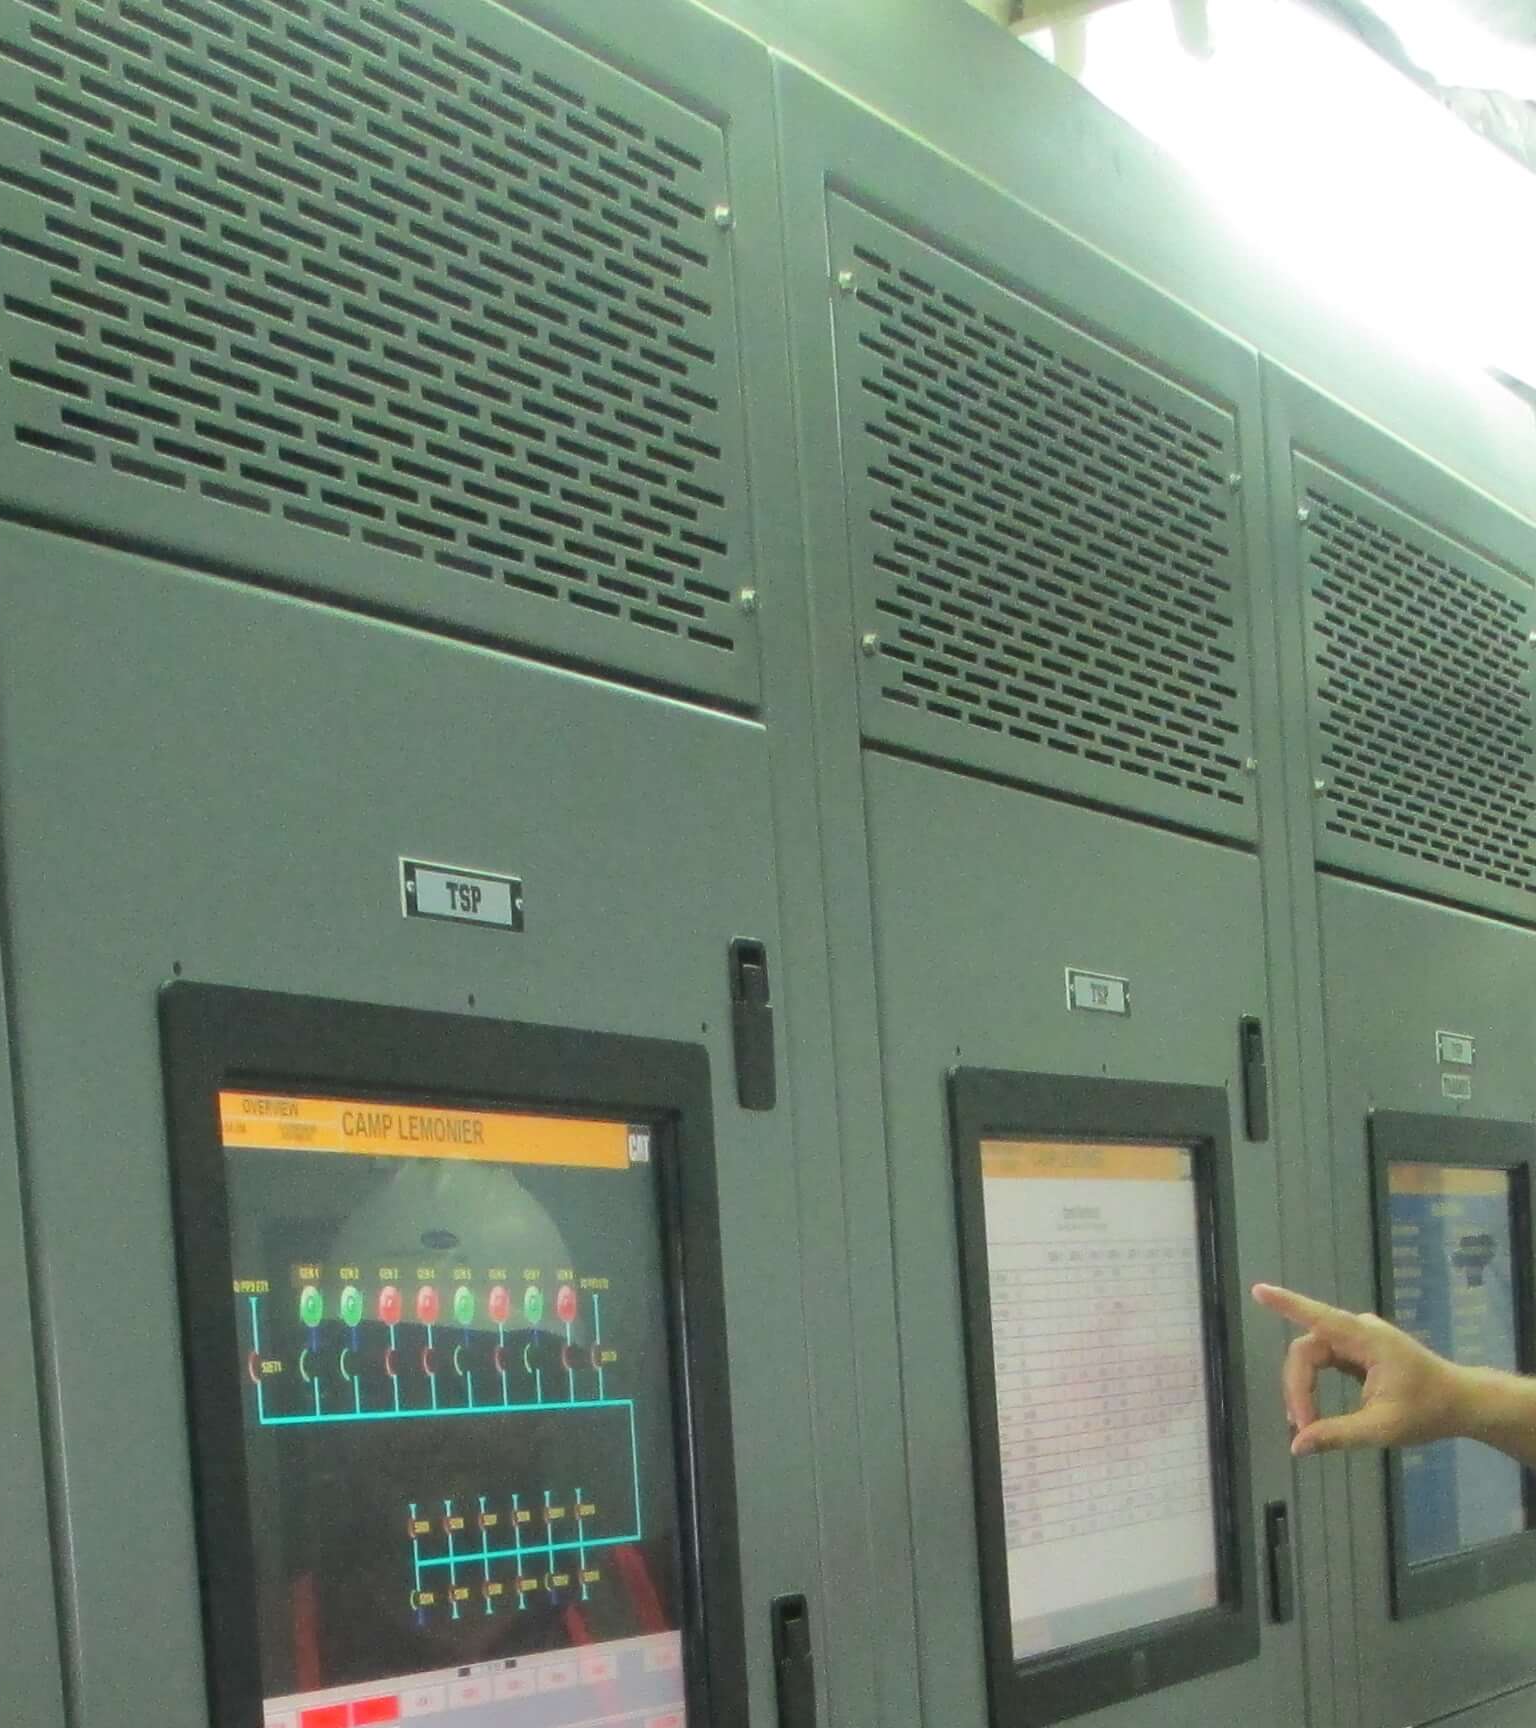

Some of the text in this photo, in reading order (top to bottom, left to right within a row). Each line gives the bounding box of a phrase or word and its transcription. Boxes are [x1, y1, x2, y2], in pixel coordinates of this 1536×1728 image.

[446, 881, 482, 913] TSP
[342, 1111, 391, 1138] CAMP
[398, 1115, 485, 1144] LEMONIER
